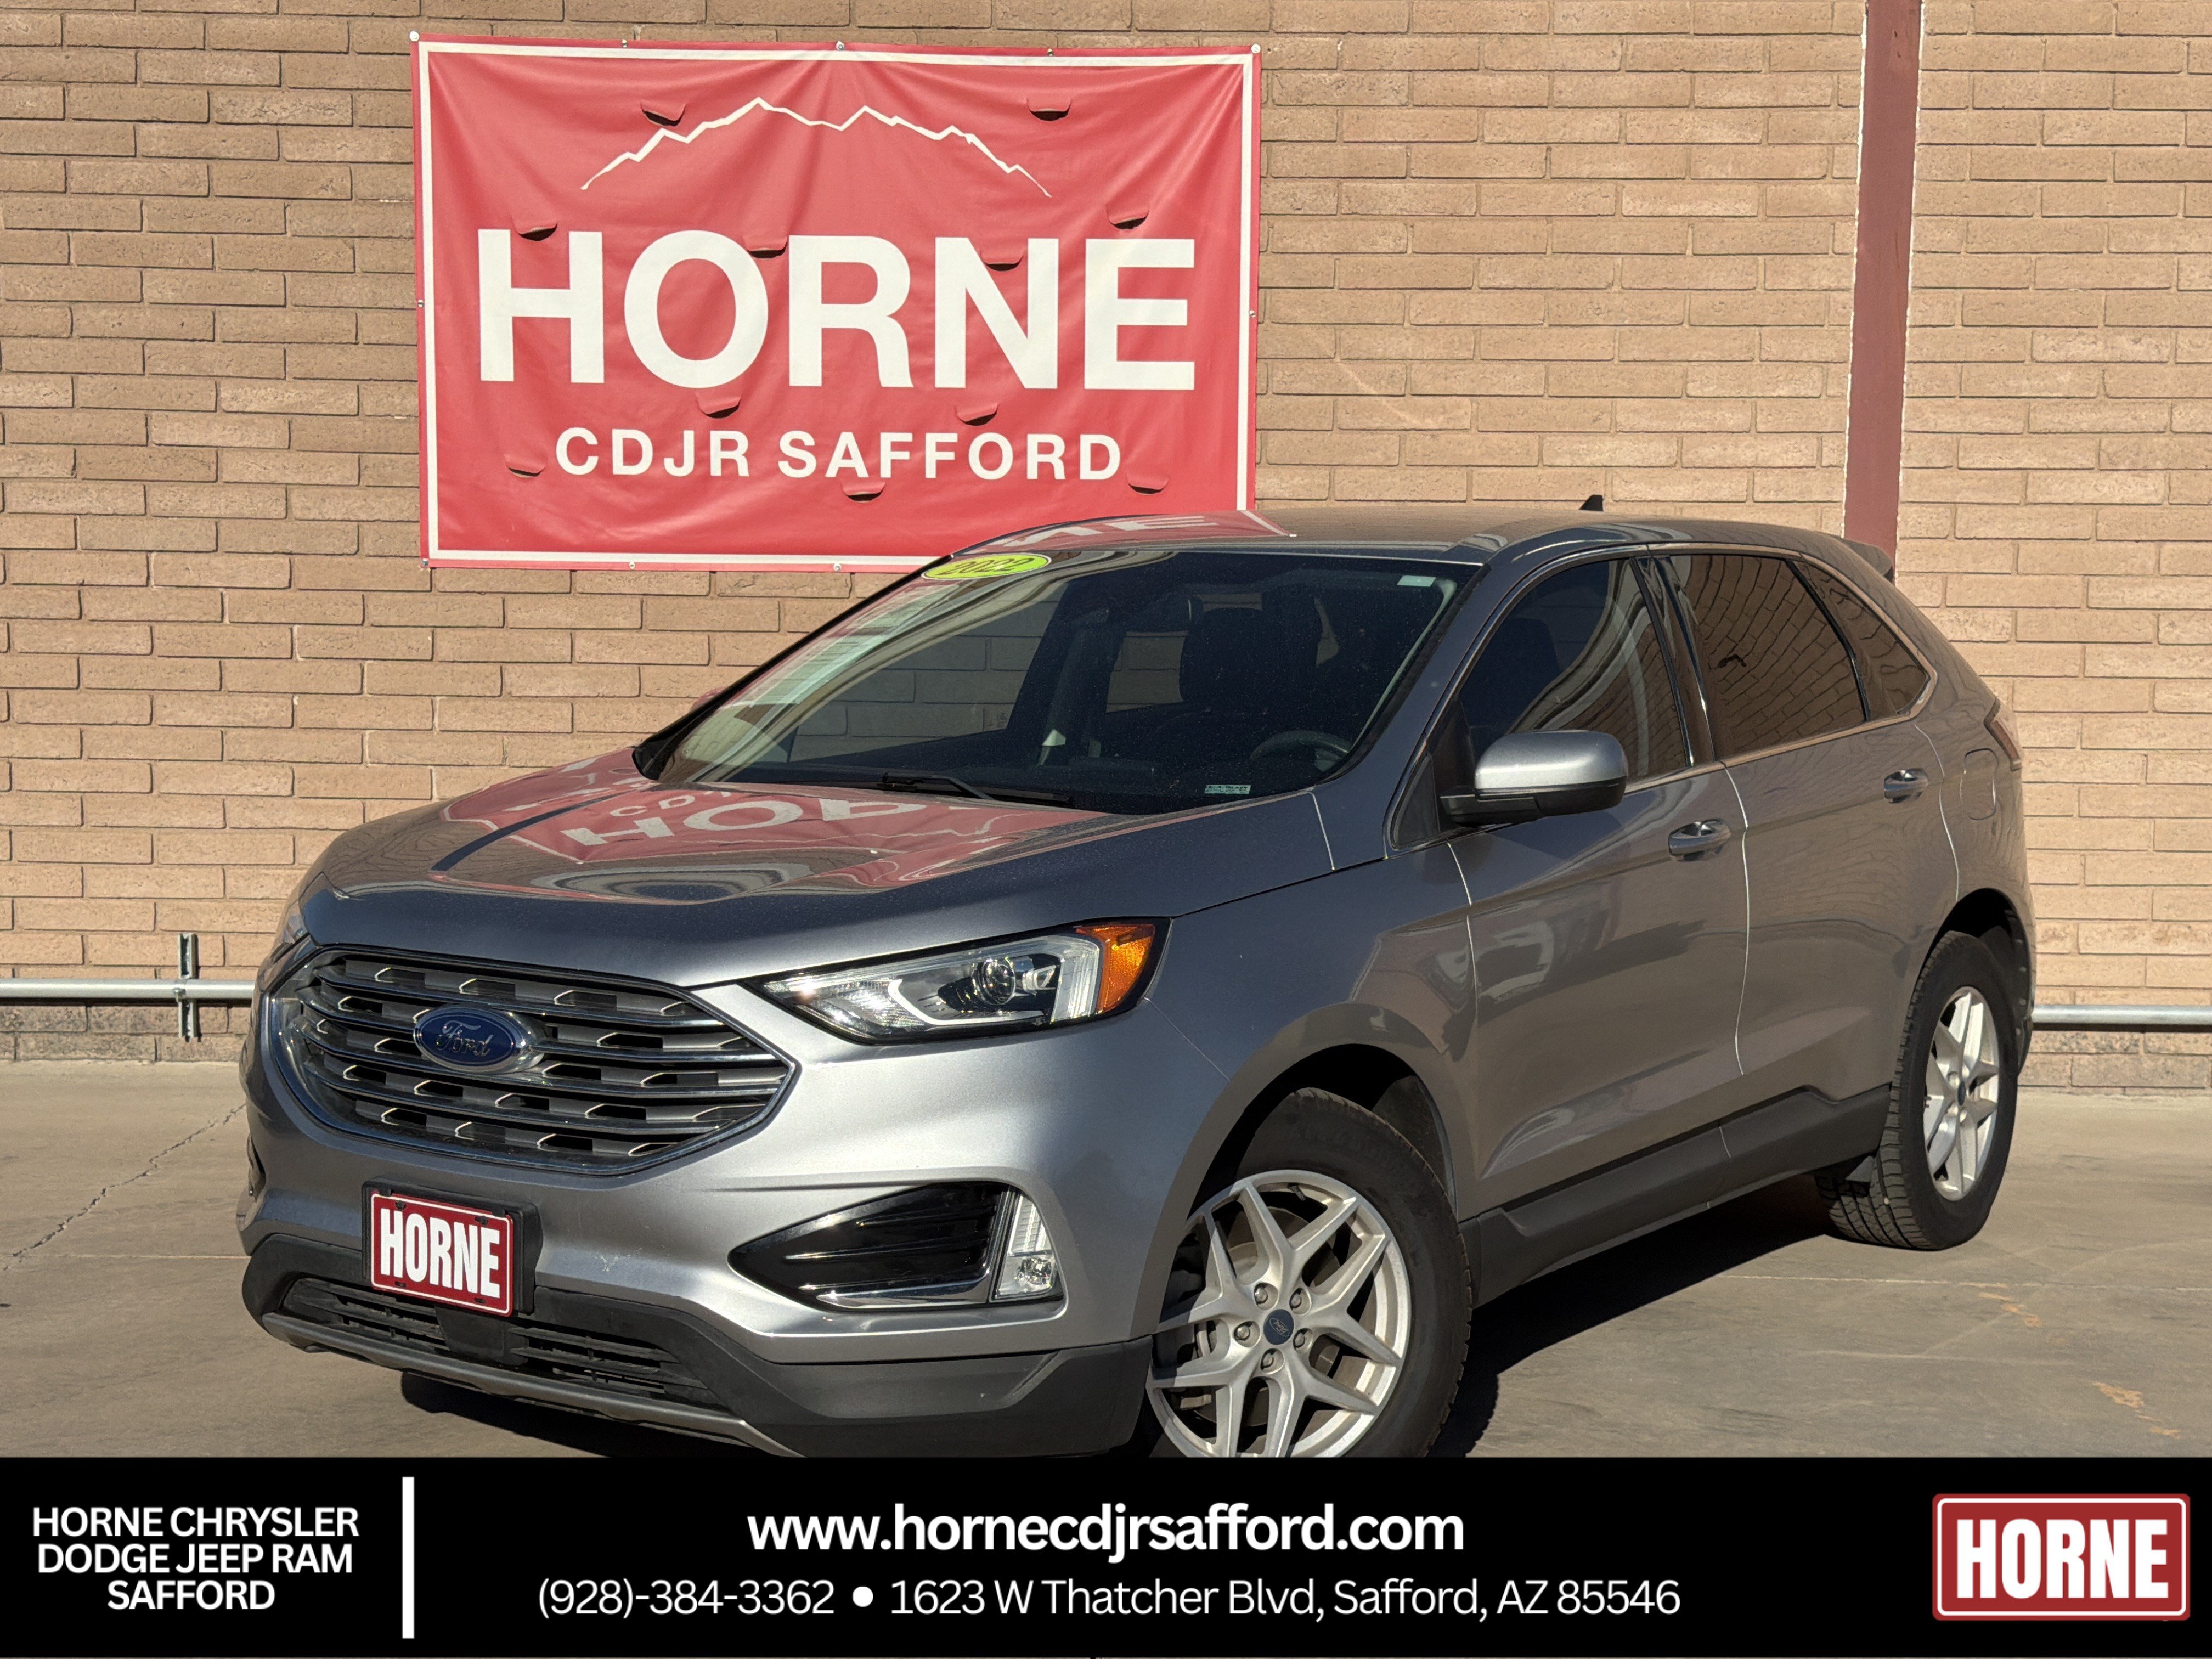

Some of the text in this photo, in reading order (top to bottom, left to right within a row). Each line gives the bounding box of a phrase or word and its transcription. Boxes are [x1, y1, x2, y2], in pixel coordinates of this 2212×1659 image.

[478, 229, 1195, 390] HORNE
[556, 427, 1121, 481] CDJR SAFFORD
[935, 558, 1035, 576] 2022
[436, 1020, 494, 1057] Ford
[380, 1209, 501, 1299] HORNE
